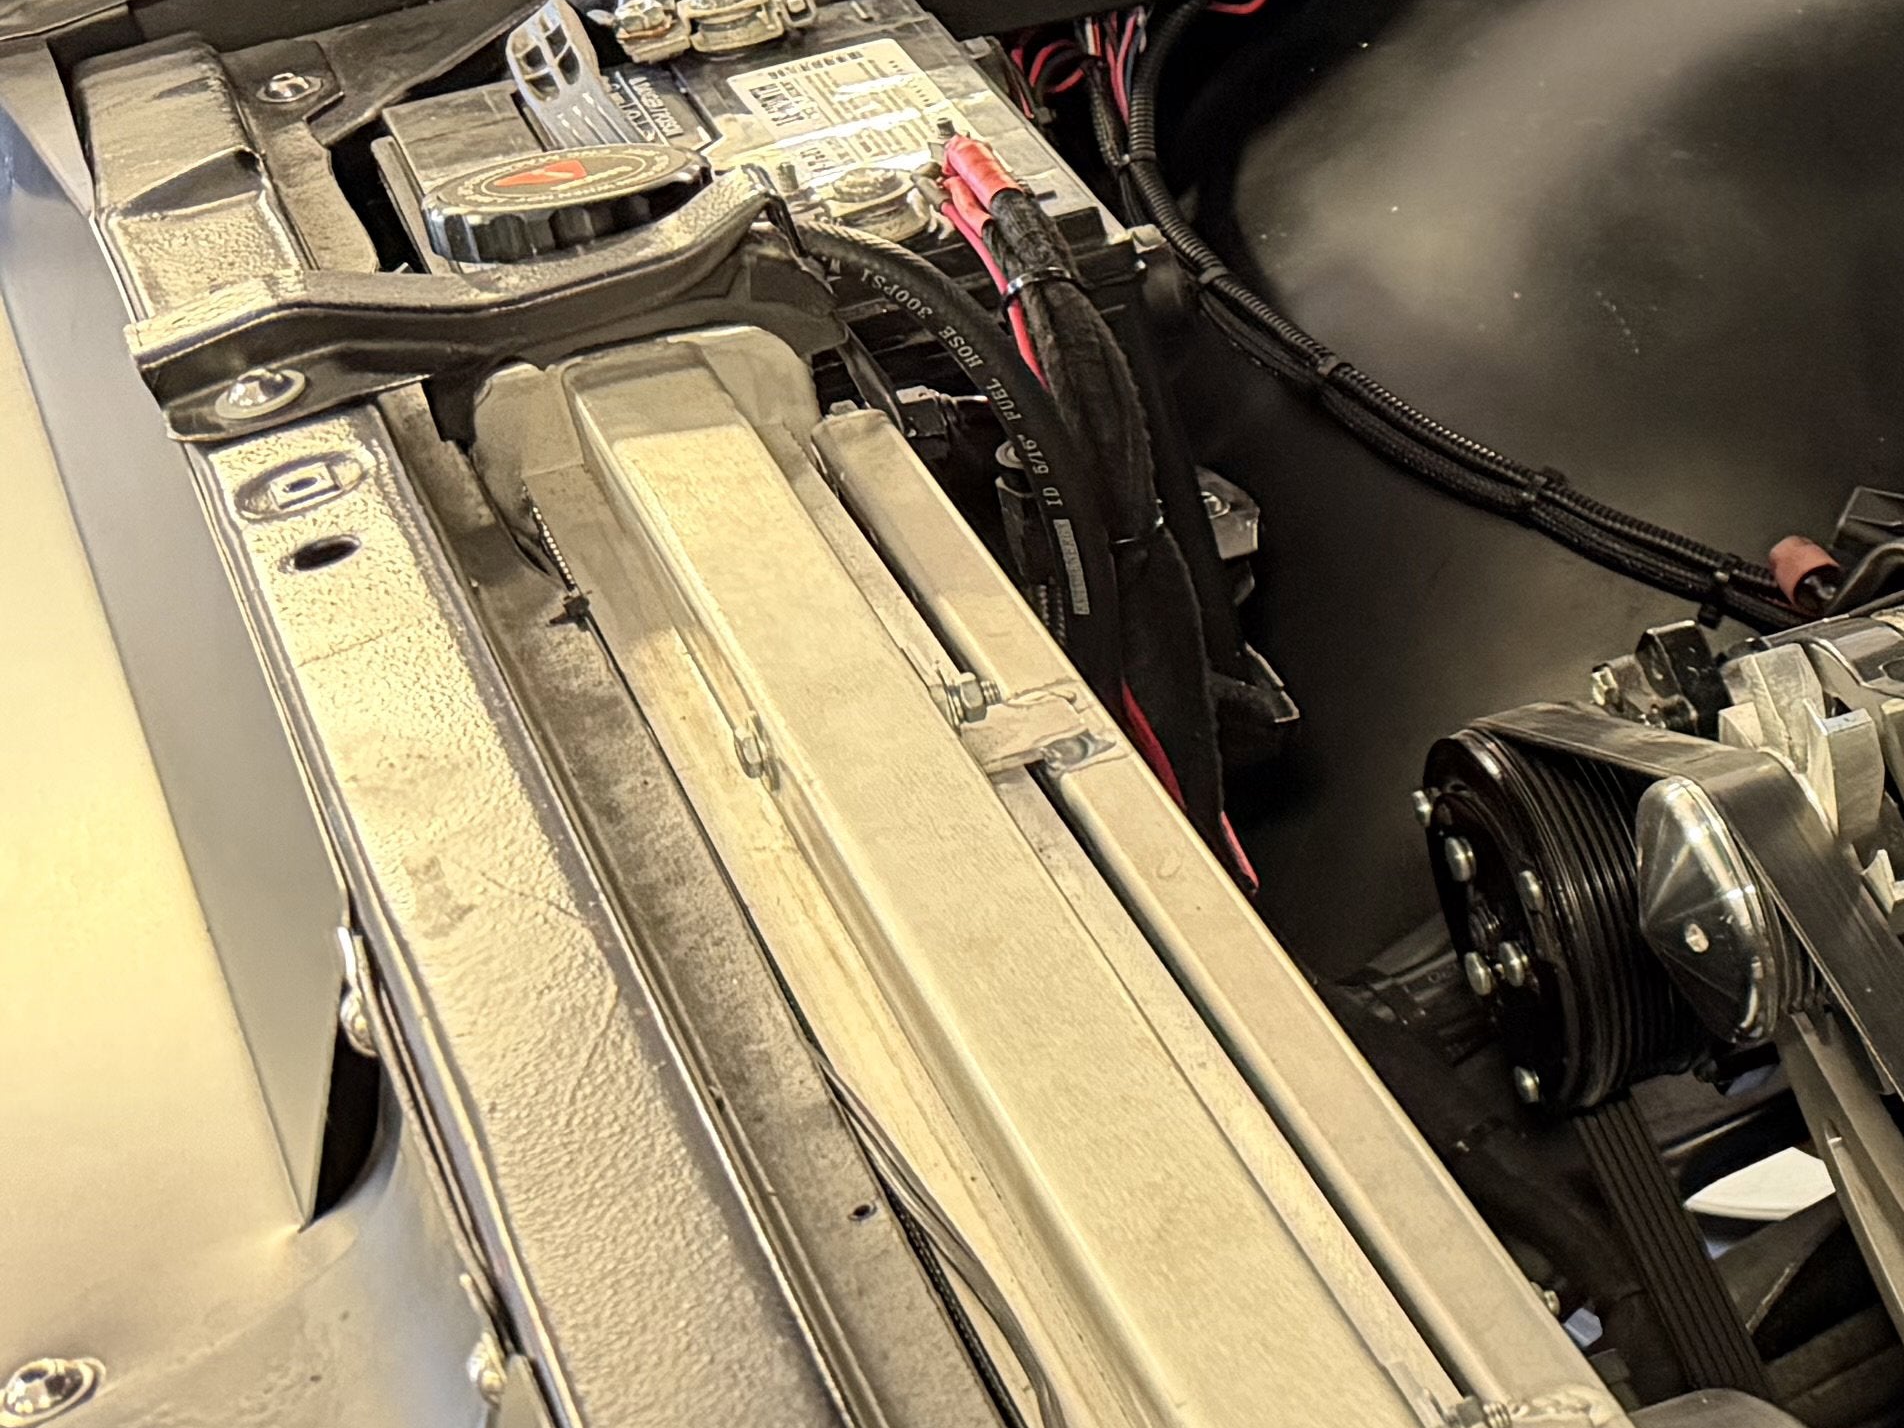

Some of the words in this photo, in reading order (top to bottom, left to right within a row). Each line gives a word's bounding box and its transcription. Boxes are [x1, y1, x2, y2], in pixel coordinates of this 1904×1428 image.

[859, 268, 935, 320] 300PSI
[938, 325, 985, 369] HOSE
[986, 377, 1023, 422] FUEL
[1042, 486, 1064, 507] ID
